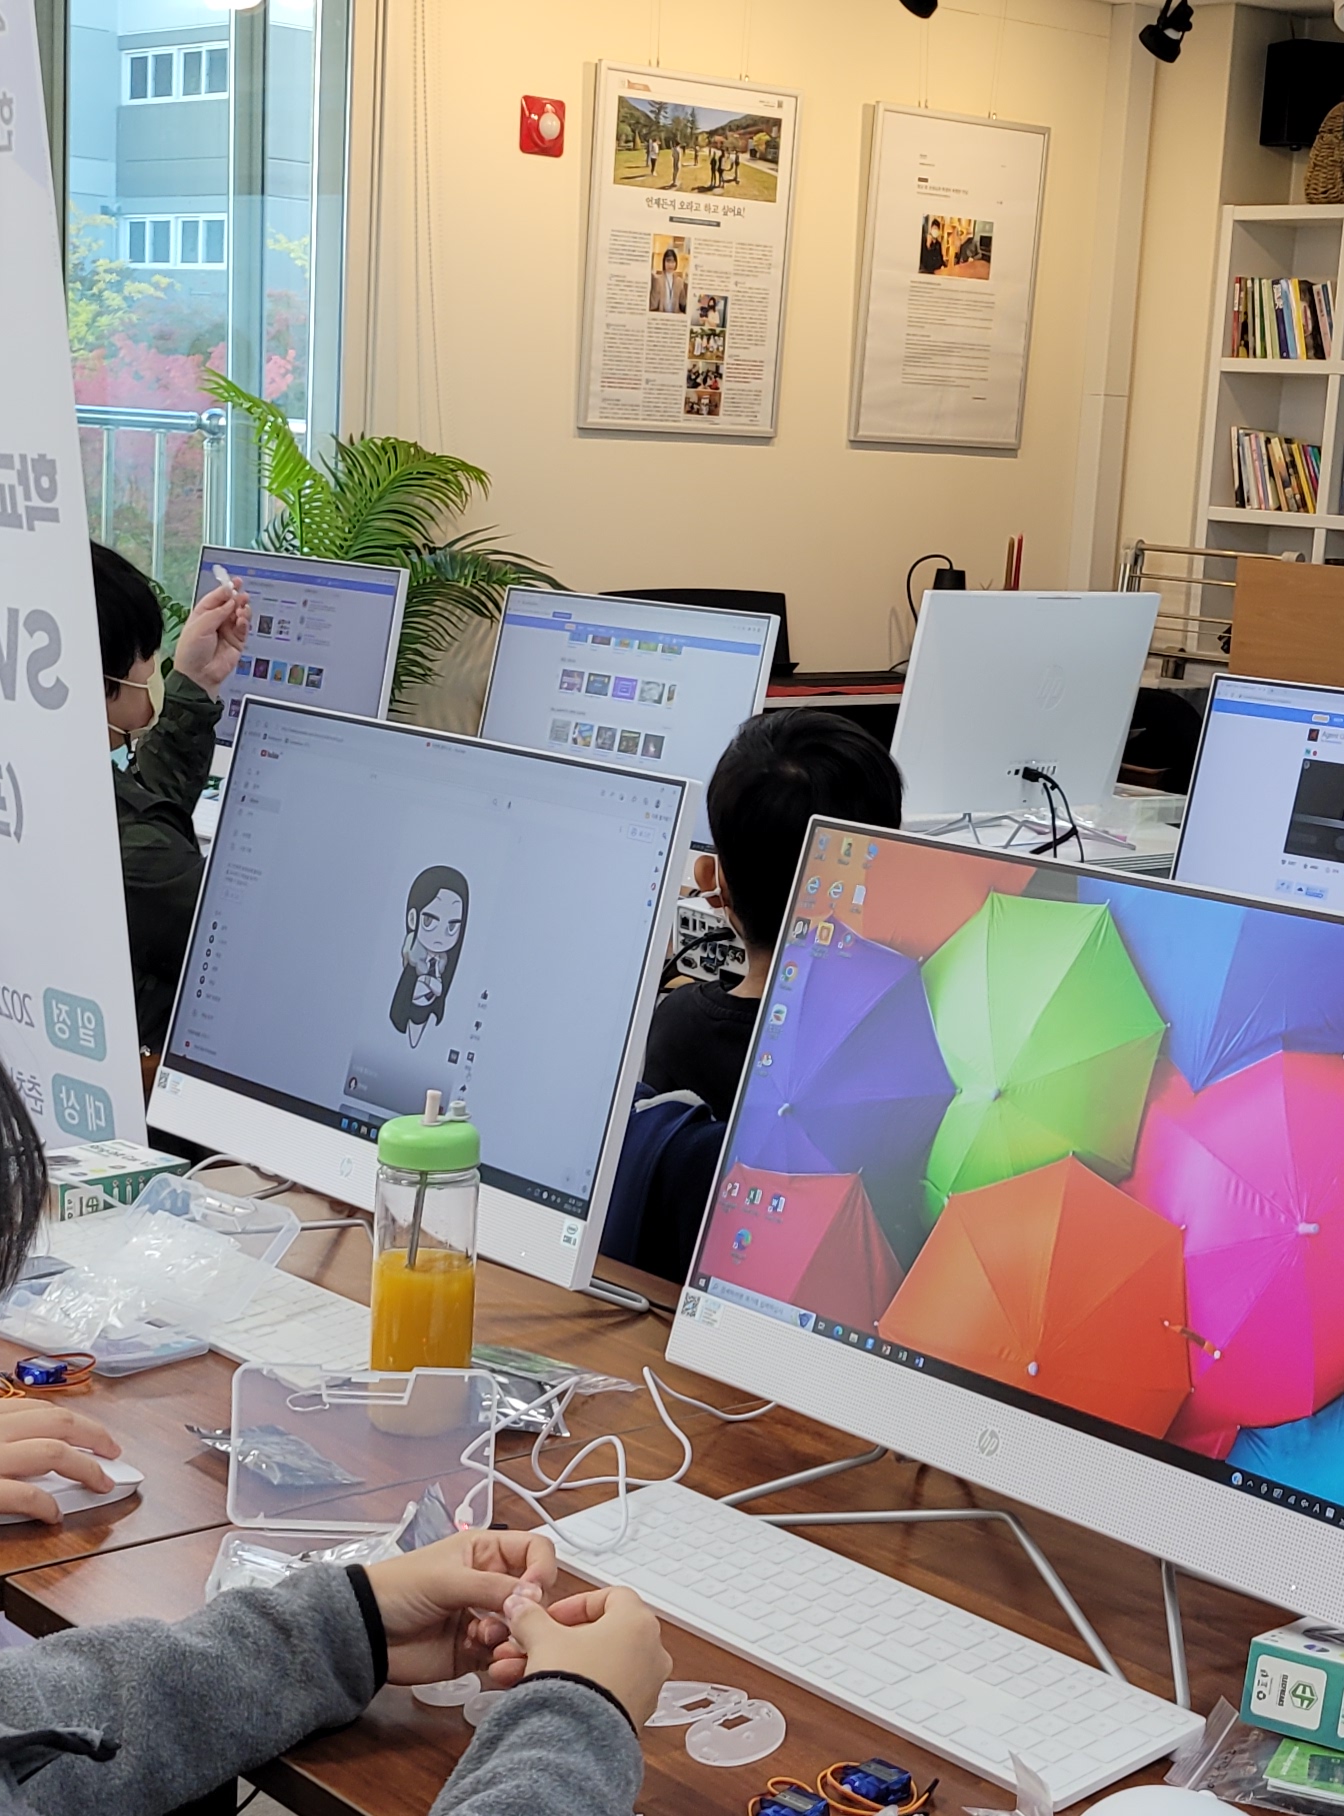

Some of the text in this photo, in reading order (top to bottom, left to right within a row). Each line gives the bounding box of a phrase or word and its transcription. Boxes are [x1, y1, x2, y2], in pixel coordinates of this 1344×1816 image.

[645, 196, 746, 218] 언제든지 오라고 하고 싶어요!
